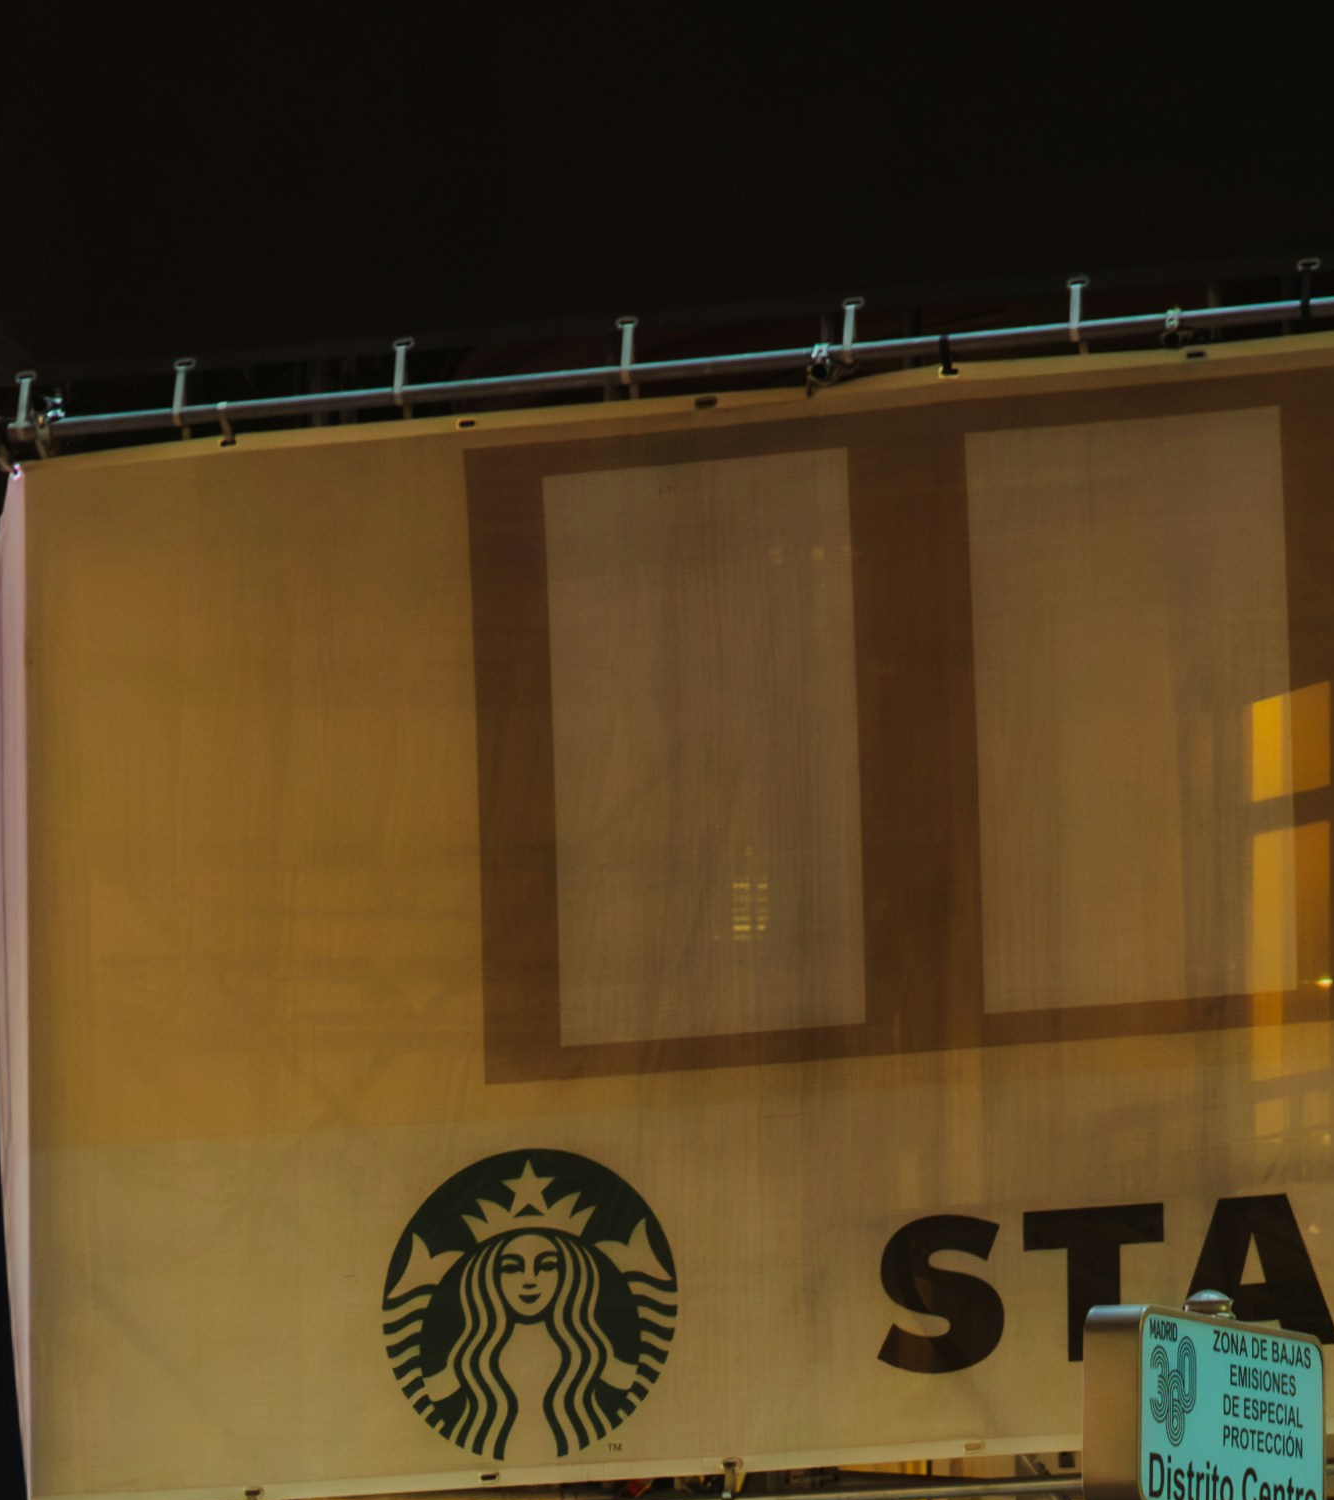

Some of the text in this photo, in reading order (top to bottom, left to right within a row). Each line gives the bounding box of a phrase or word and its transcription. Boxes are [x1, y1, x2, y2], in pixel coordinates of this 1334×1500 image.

[1149, 1318, 1178, 1343] MADRID
[1212, 1329, 1312, 1370] ZONA DE BAJAS
[1229, 1364, 1297, 1397] EMISIONES
[1223, 1394, 1304, 1429] DE ESPECIAL
[1222, 1424, 1304, 1460] PROTECCIÓN
